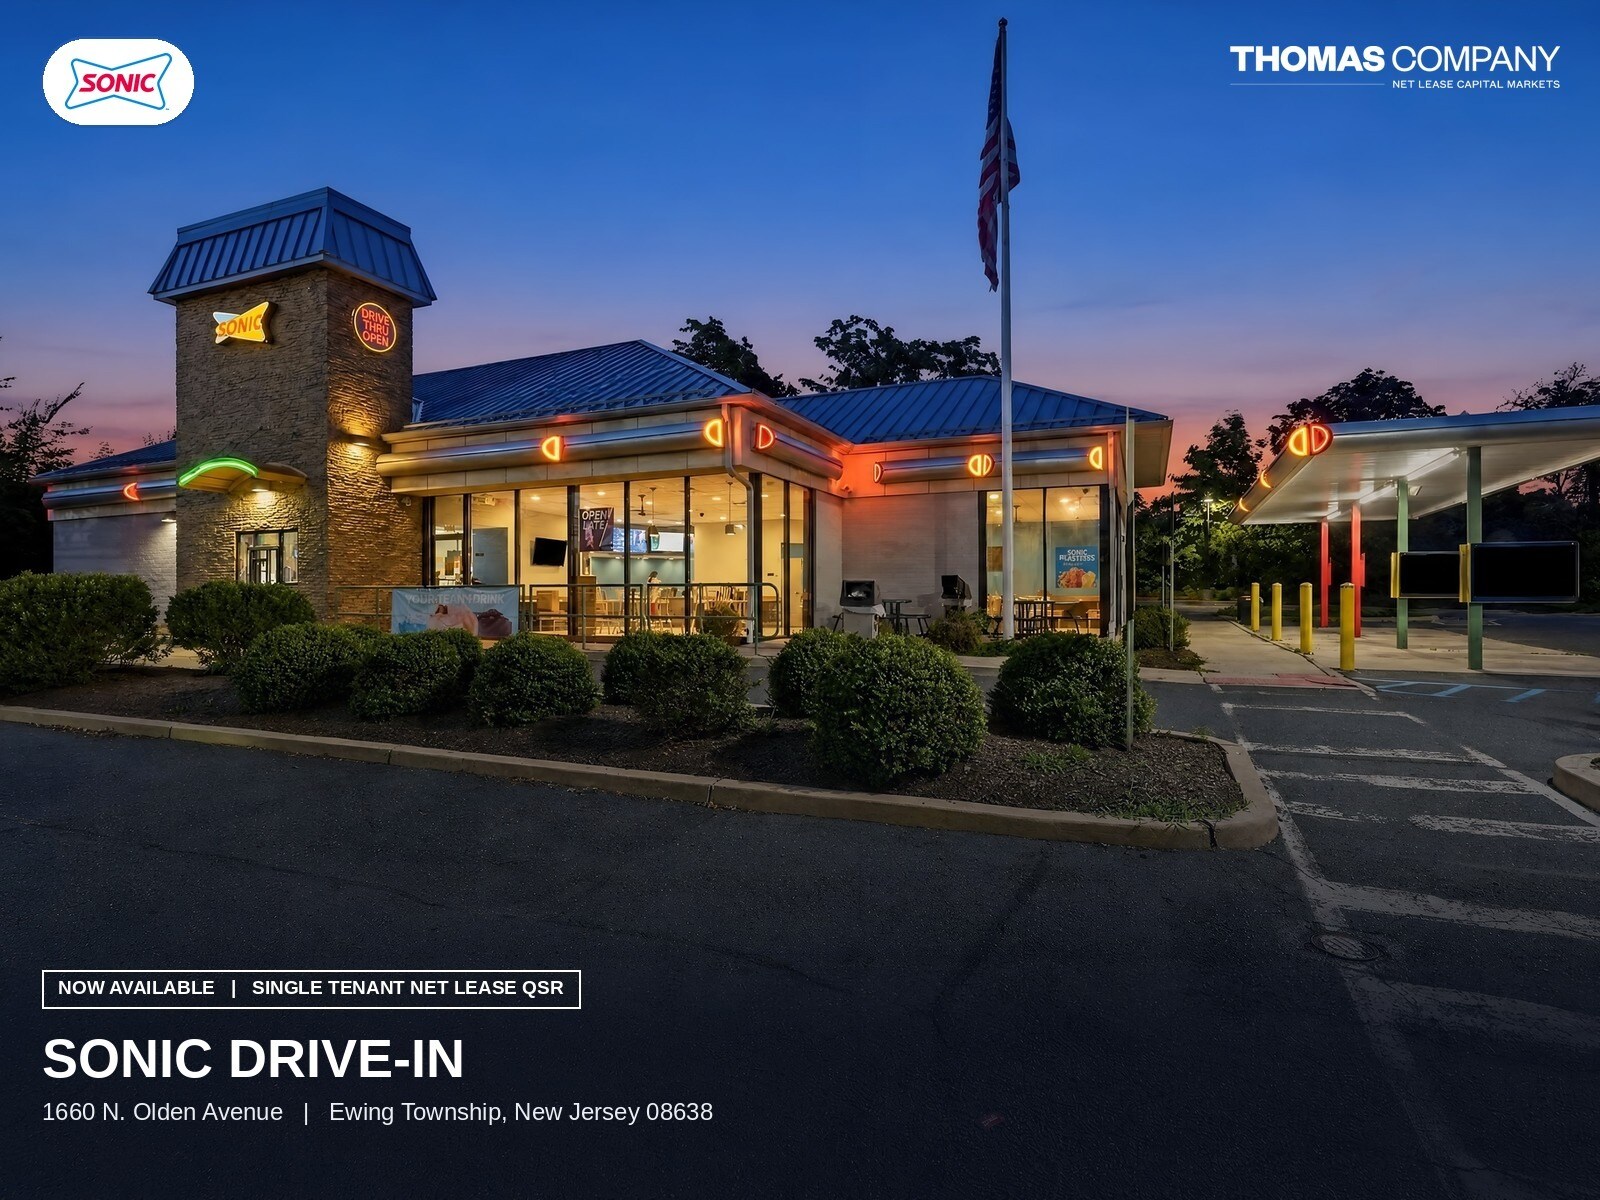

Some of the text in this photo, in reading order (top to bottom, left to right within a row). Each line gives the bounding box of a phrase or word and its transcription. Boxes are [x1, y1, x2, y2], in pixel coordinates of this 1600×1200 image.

[218, 314, 263, 336] SONIC
[361, 307, 390, 327] DRIVE
[362, 319, 390, 336] THRU
[362, 330, 389, 347] OPEN
[581, 510, 608, 521] OPEN
[582, 520, 606, 531] LATE
